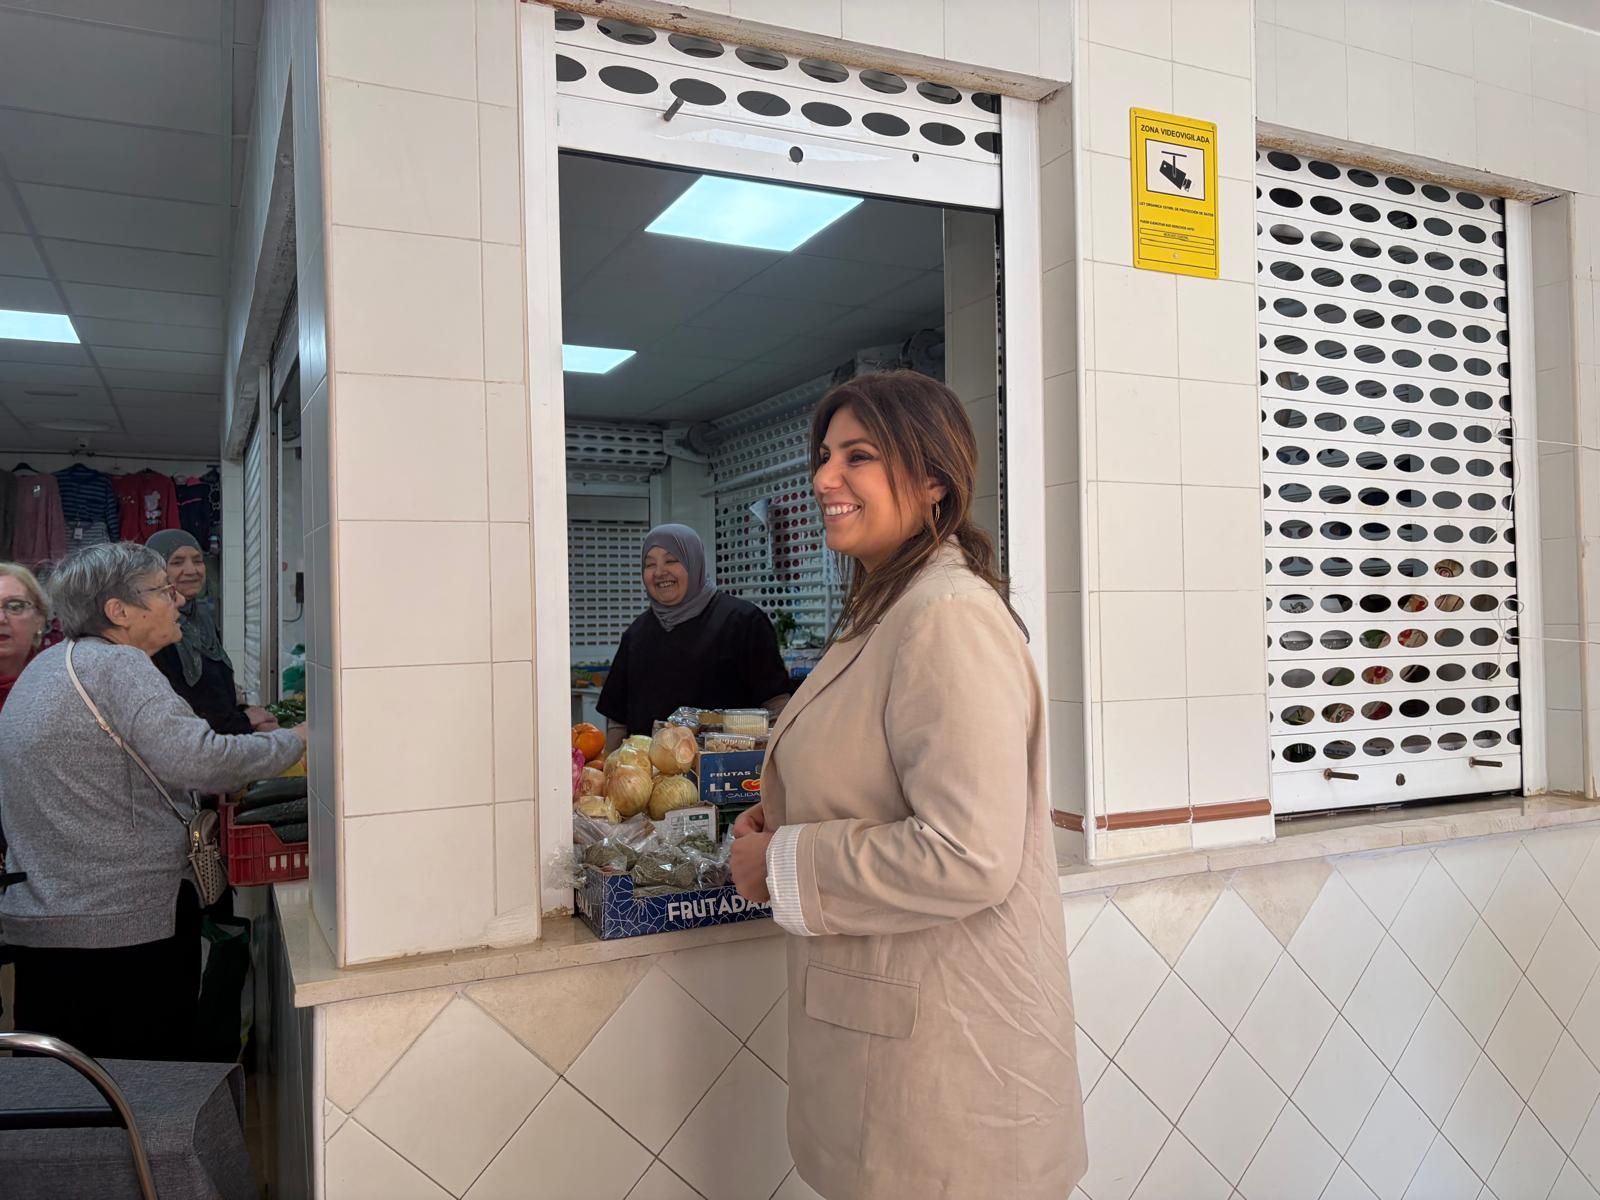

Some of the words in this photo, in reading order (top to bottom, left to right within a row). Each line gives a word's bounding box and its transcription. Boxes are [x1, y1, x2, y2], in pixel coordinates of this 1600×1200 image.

[1140, 124, 1160, 134] ZONA
[1160, 127, 1210, 144] VIDEOVIGILADA
[709, 770, 751, 778] FRUTAS
